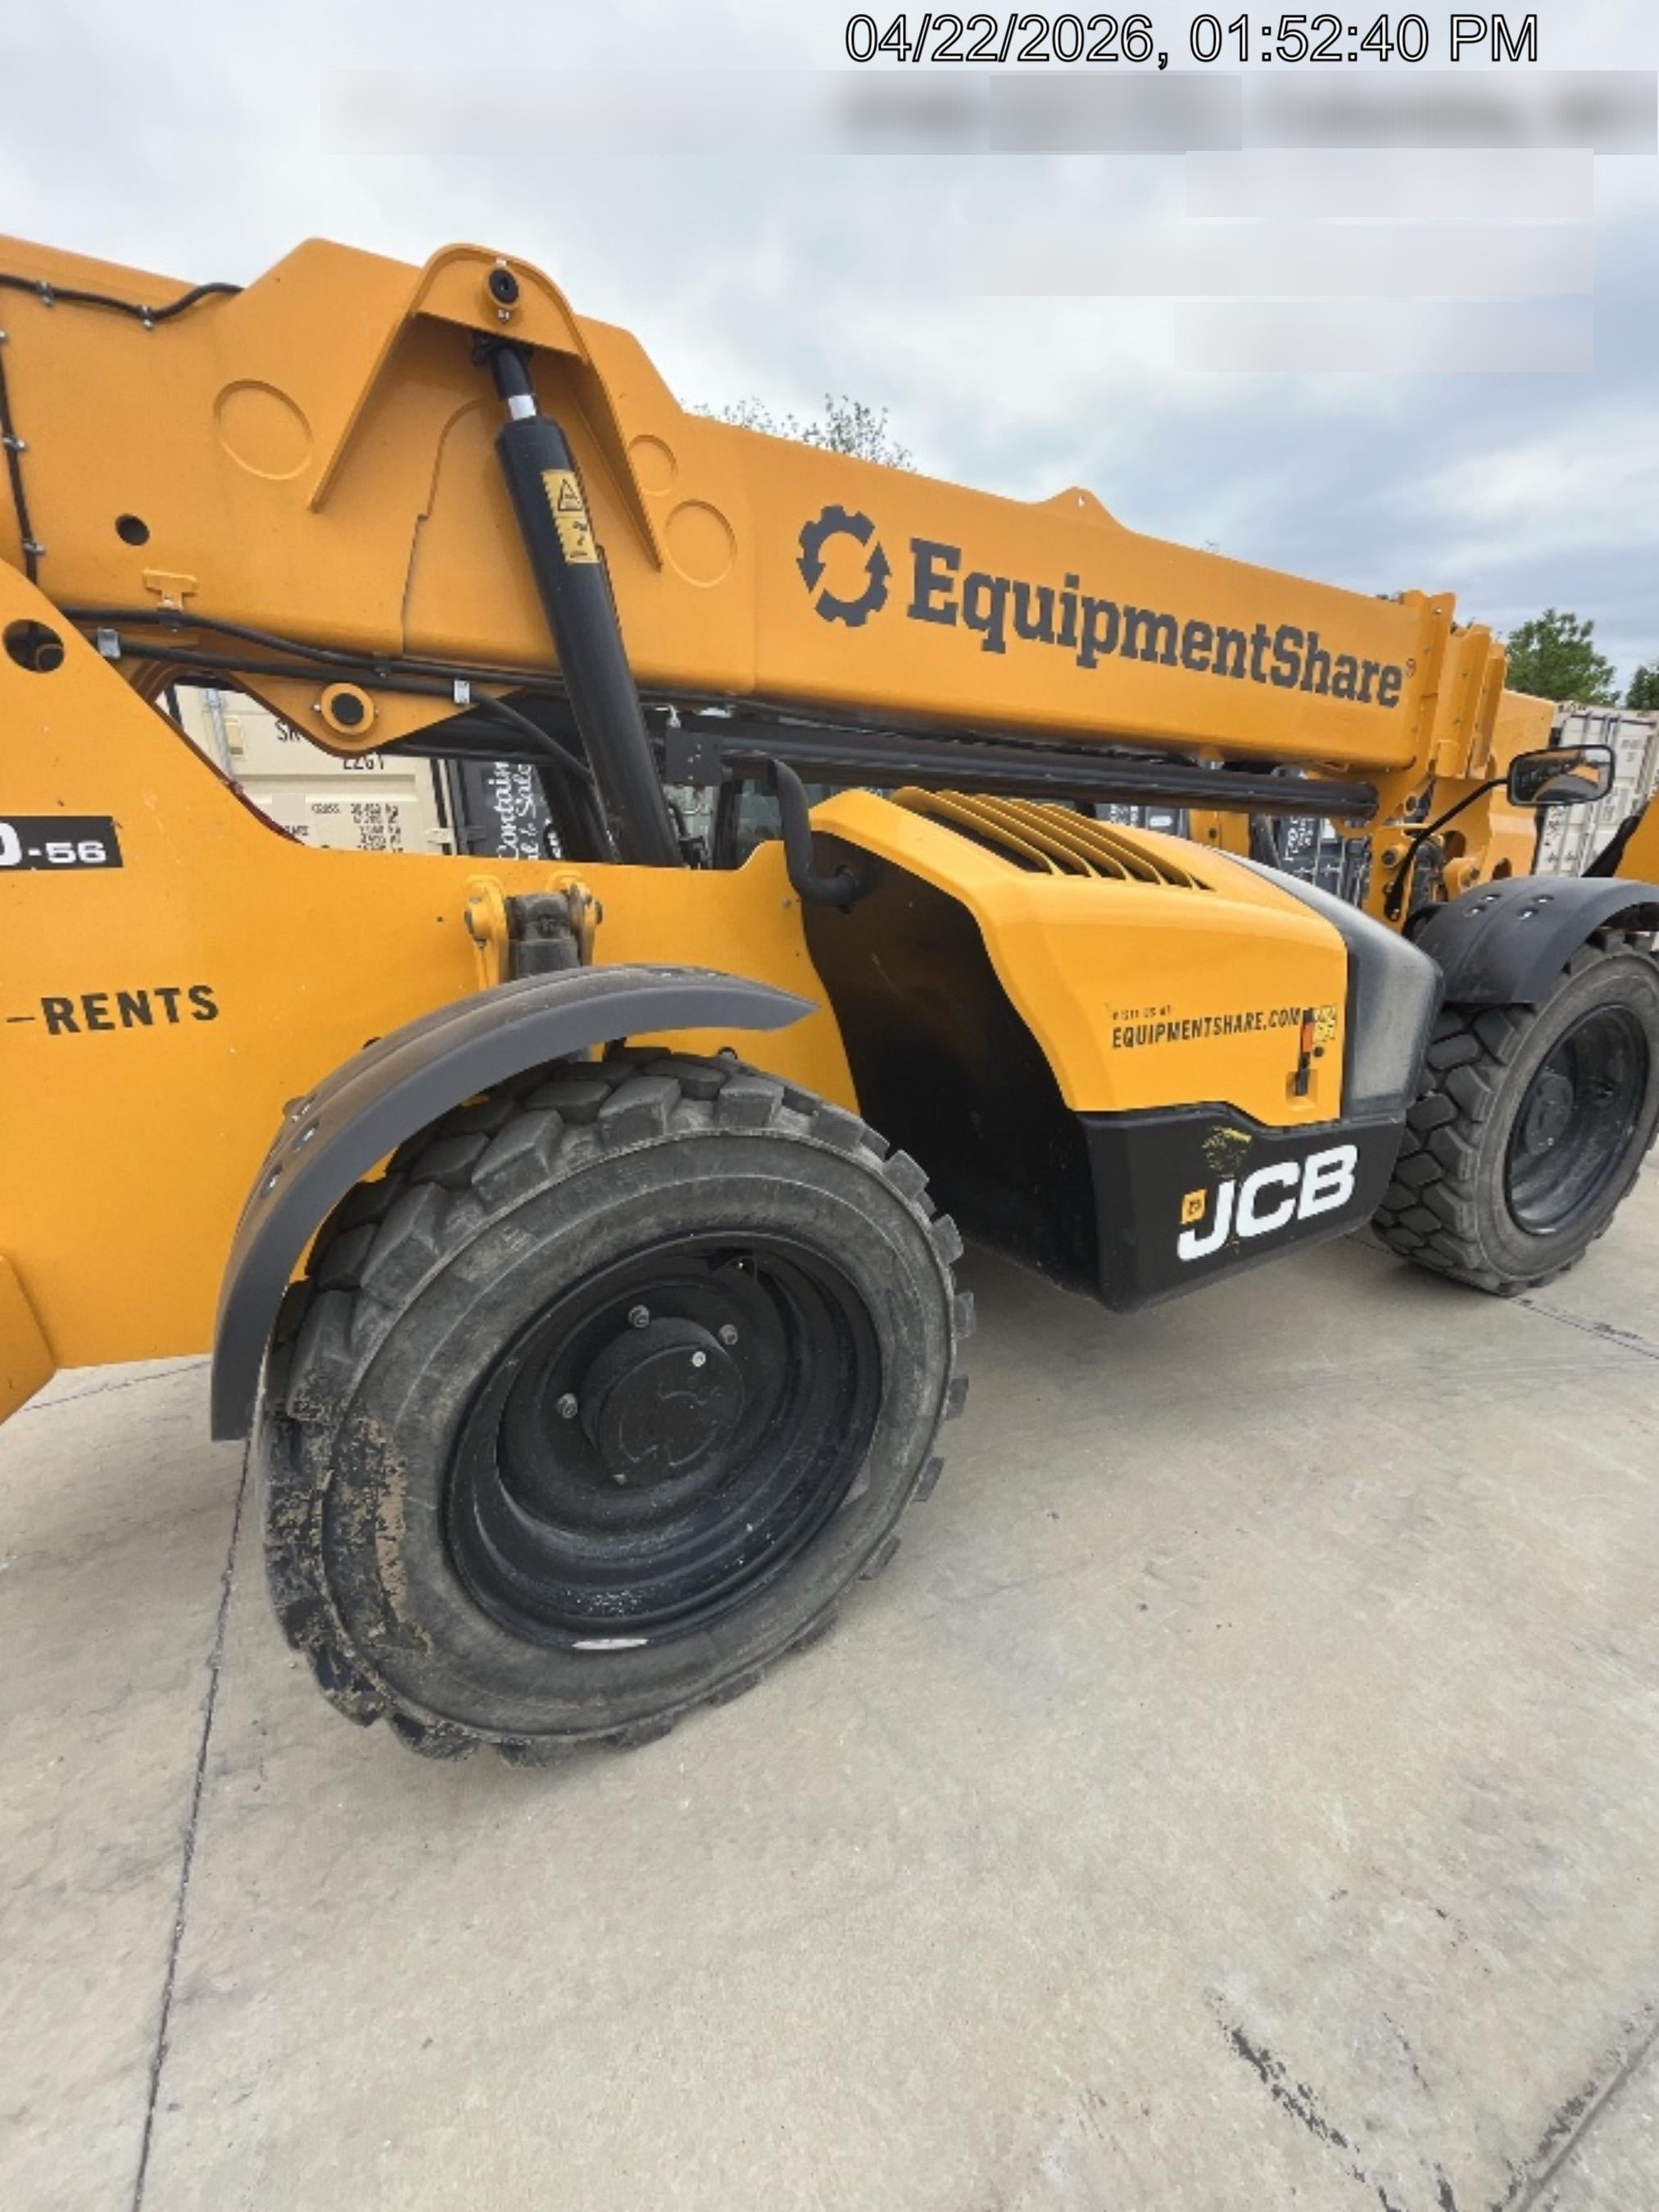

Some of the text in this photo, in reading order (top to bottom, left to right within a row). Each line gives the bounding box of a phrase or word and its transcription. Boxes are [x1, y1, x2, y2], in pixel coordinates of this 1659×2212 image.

[907, 537, 1403, 708] EquipmentShare
[1113, 1007, 1301, 1049] EQUIPMENTSHARE.COM
[1177, 1145, 1358, 1262] JCB
